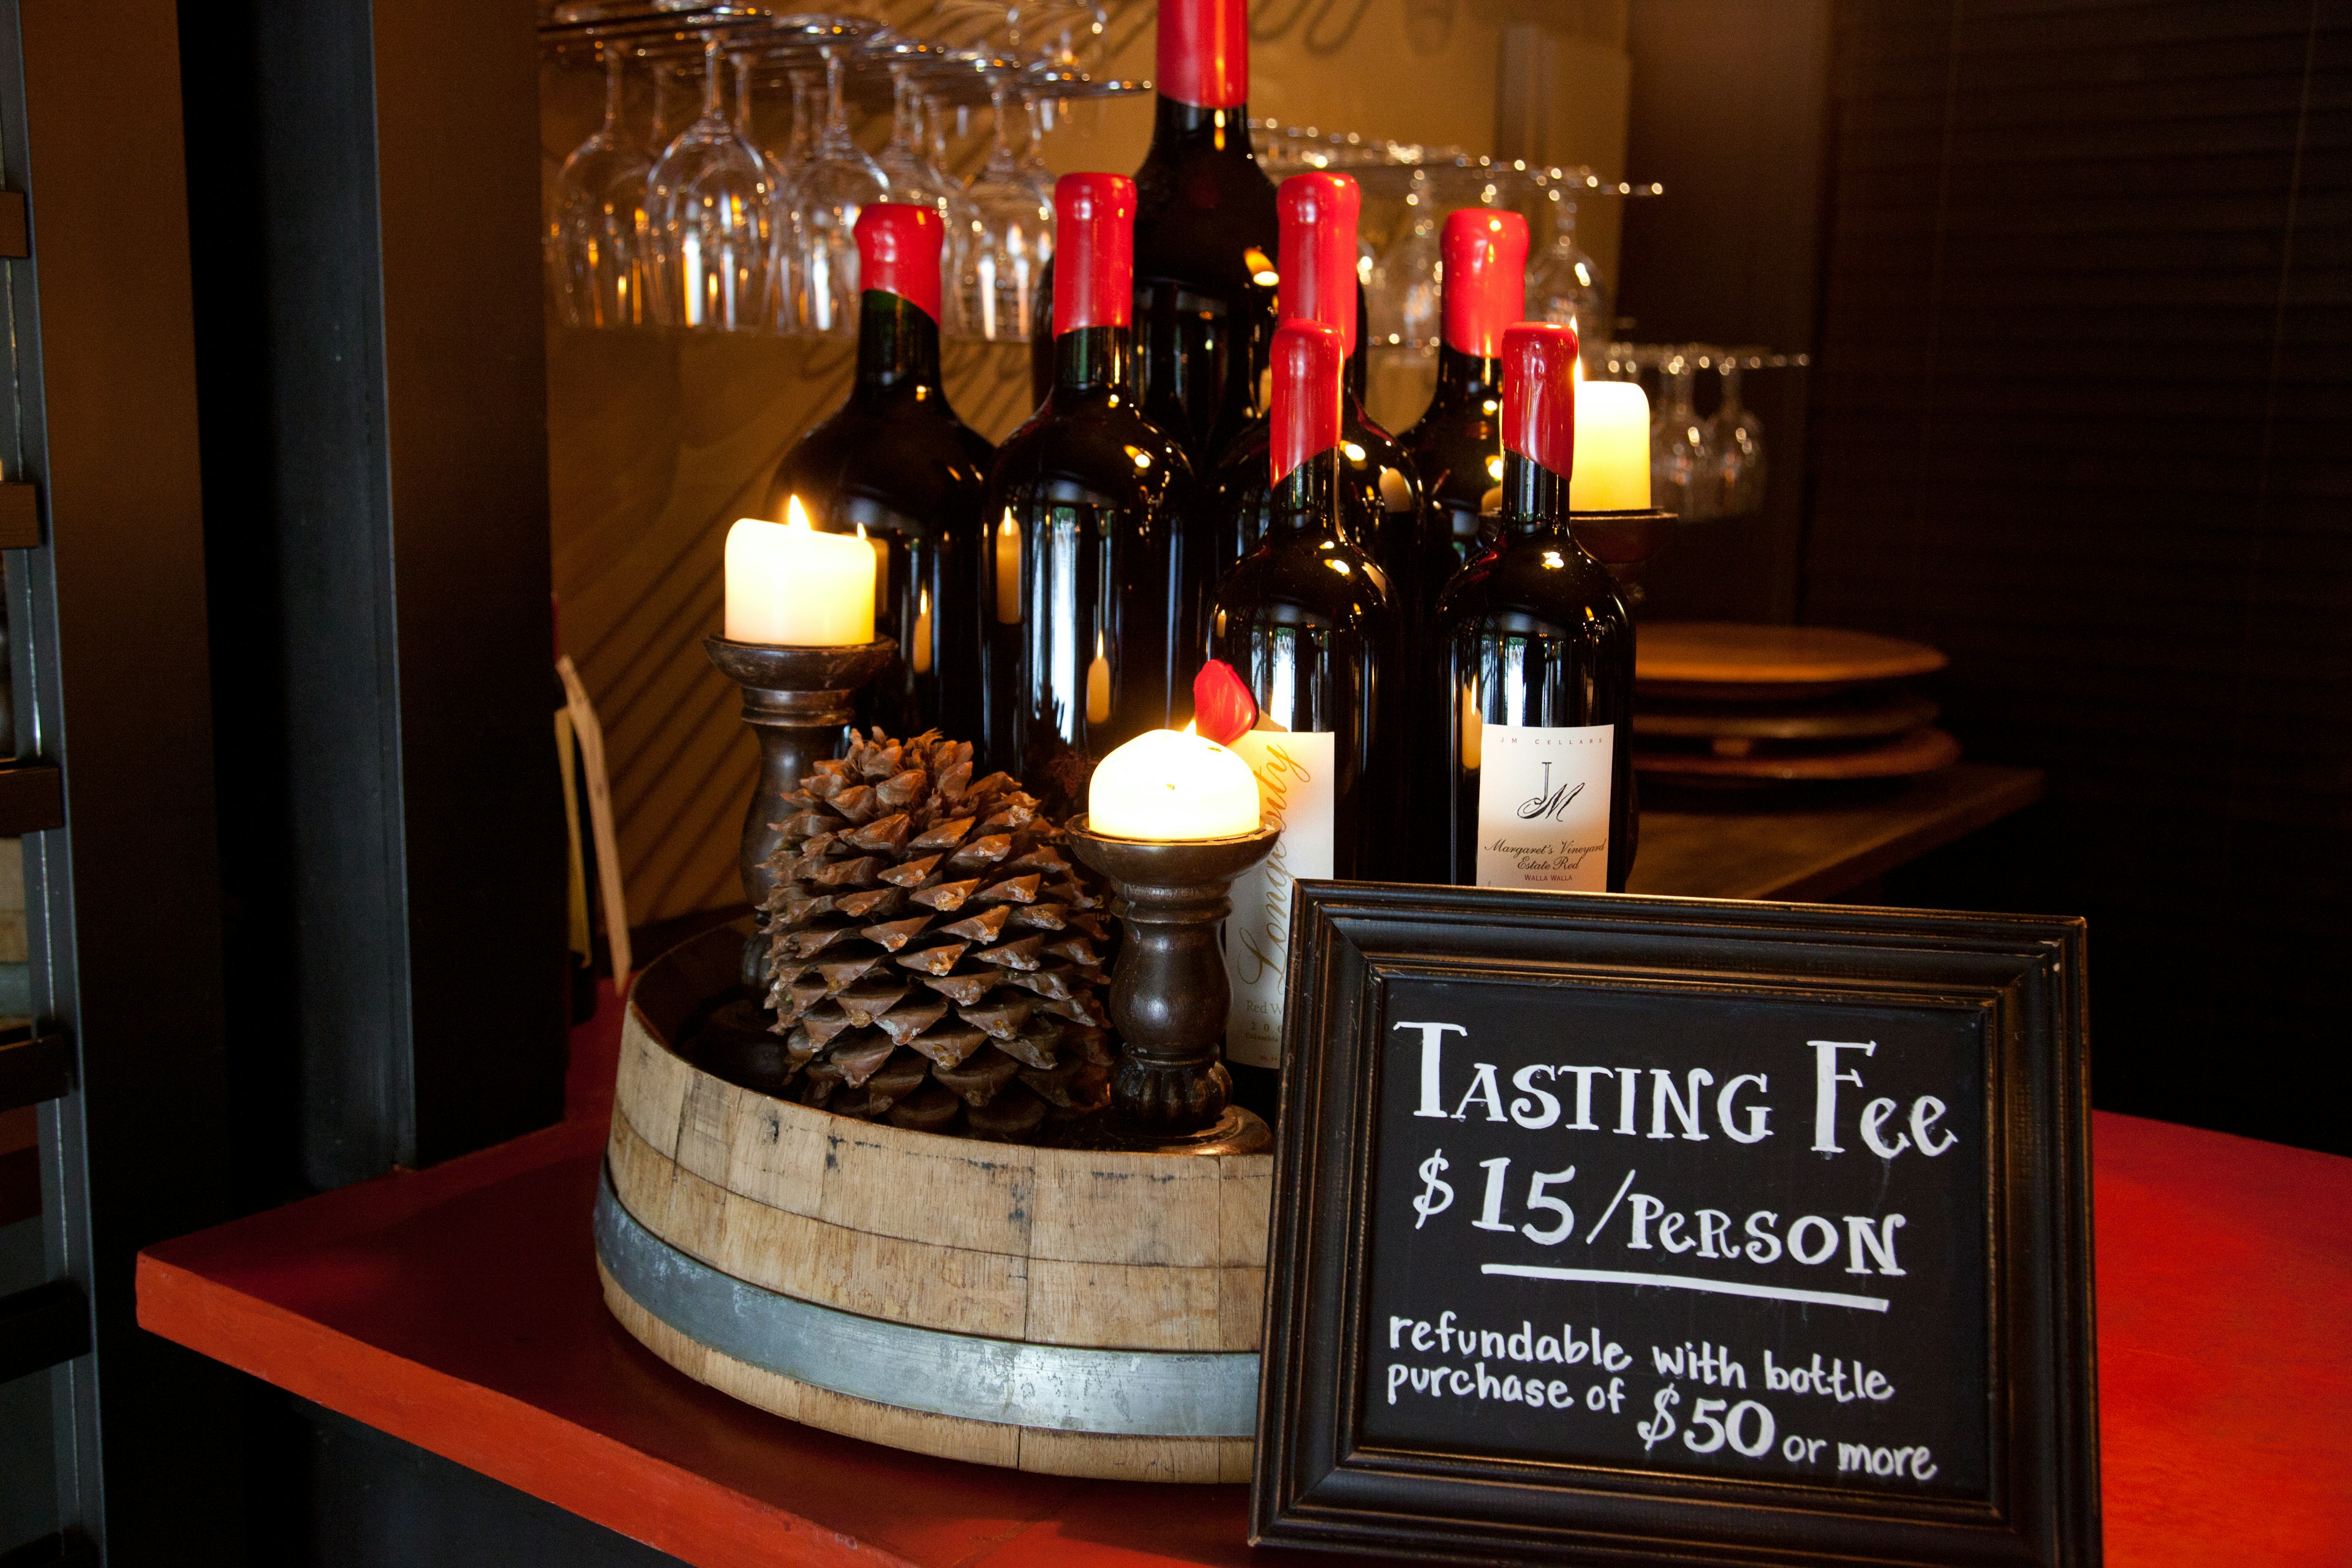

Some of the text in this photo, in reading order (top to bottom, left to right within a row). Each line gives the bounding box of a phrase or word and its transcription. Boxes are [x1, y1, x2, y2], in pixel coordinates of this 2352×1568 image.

[1485, 838, 1607, 859] Margaret's Vineyard
[1517, 856, 1583, 870] Estate Red
[1246, 1000, 1267, 1014] Red
[1393, 1021, 1958, 1159] TASTING Fee
[1389, 1311, 1895, 1401] refundable with bottle
[1387, 1362, 1937, 1480] purchase of $50 or more
